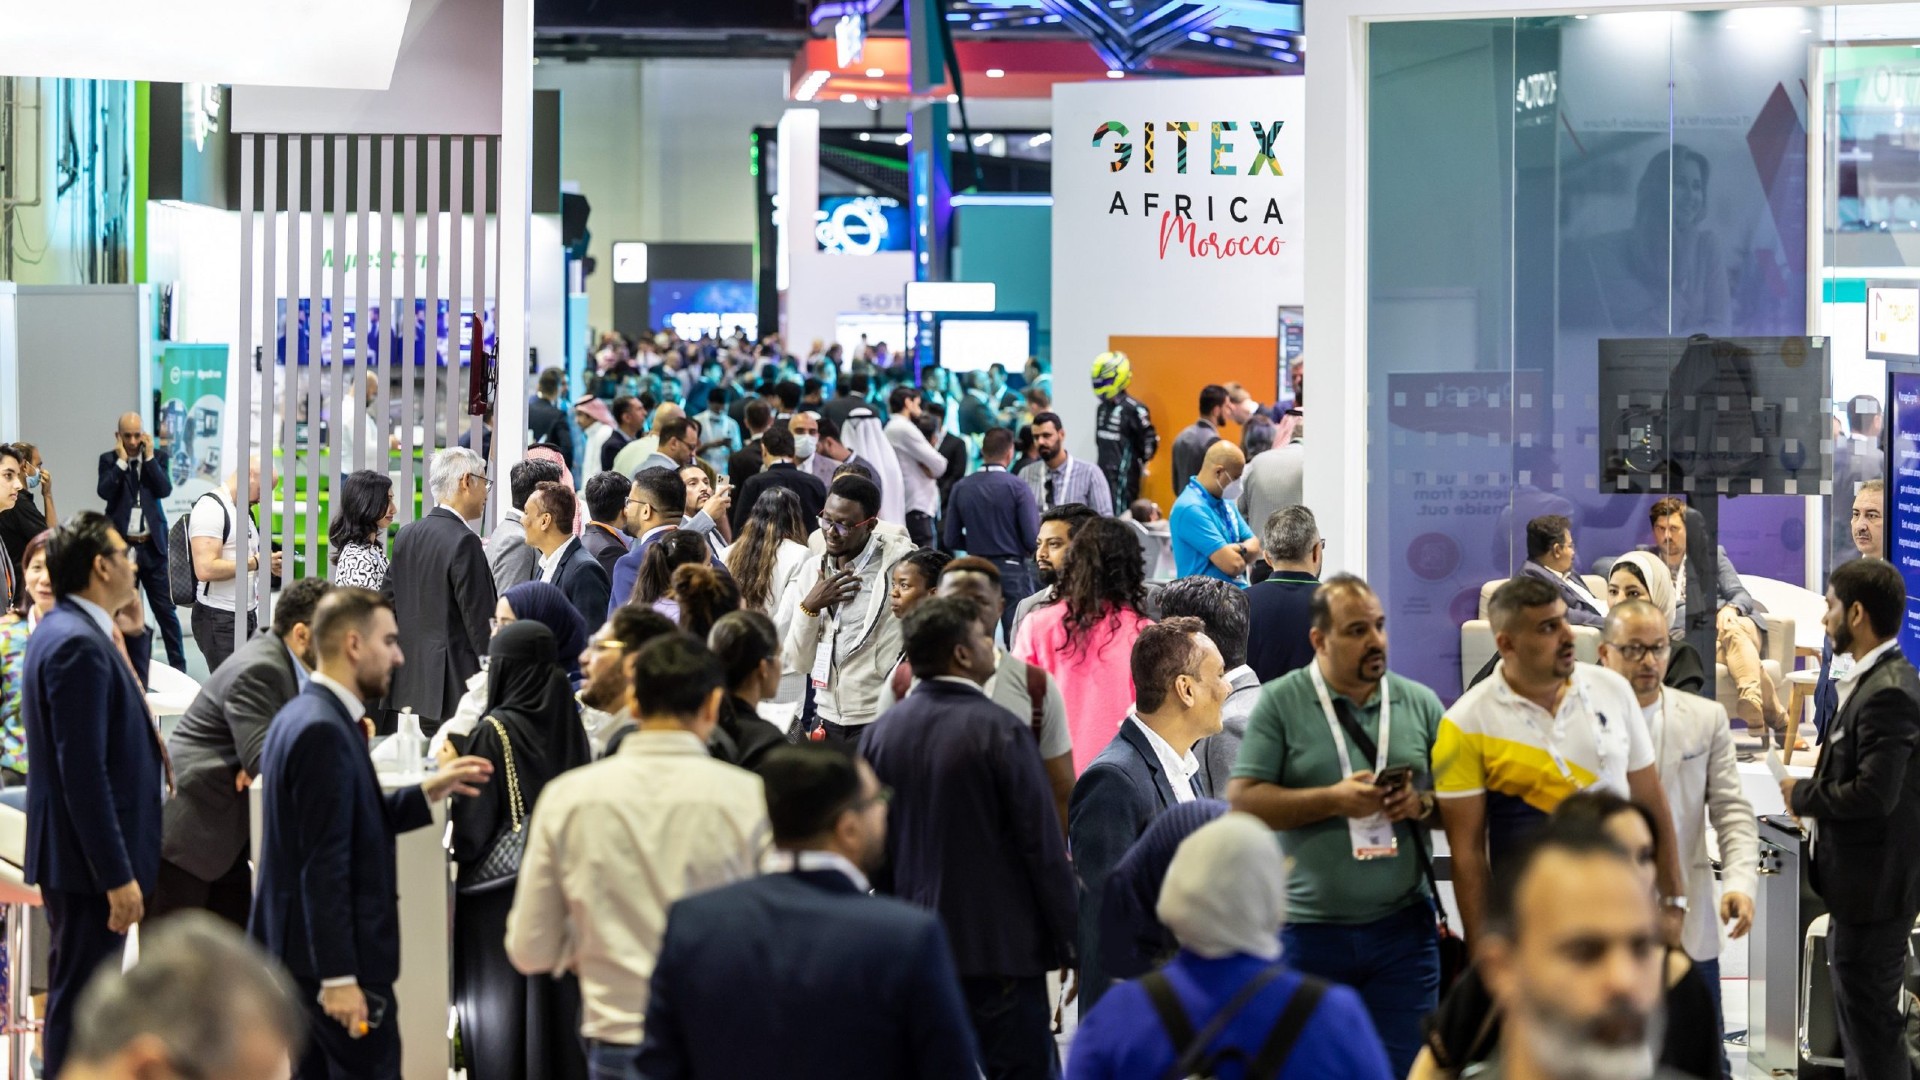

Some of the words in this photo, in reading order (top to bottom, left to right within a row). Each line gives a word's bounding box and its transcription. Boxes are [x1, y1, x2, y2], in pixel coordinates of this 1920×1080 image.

[1092, 120, 1285, 176] GITEX
[1108, 190, 1284, 225] AFRICA
[1159, 210, 1286, 260] Morocco
